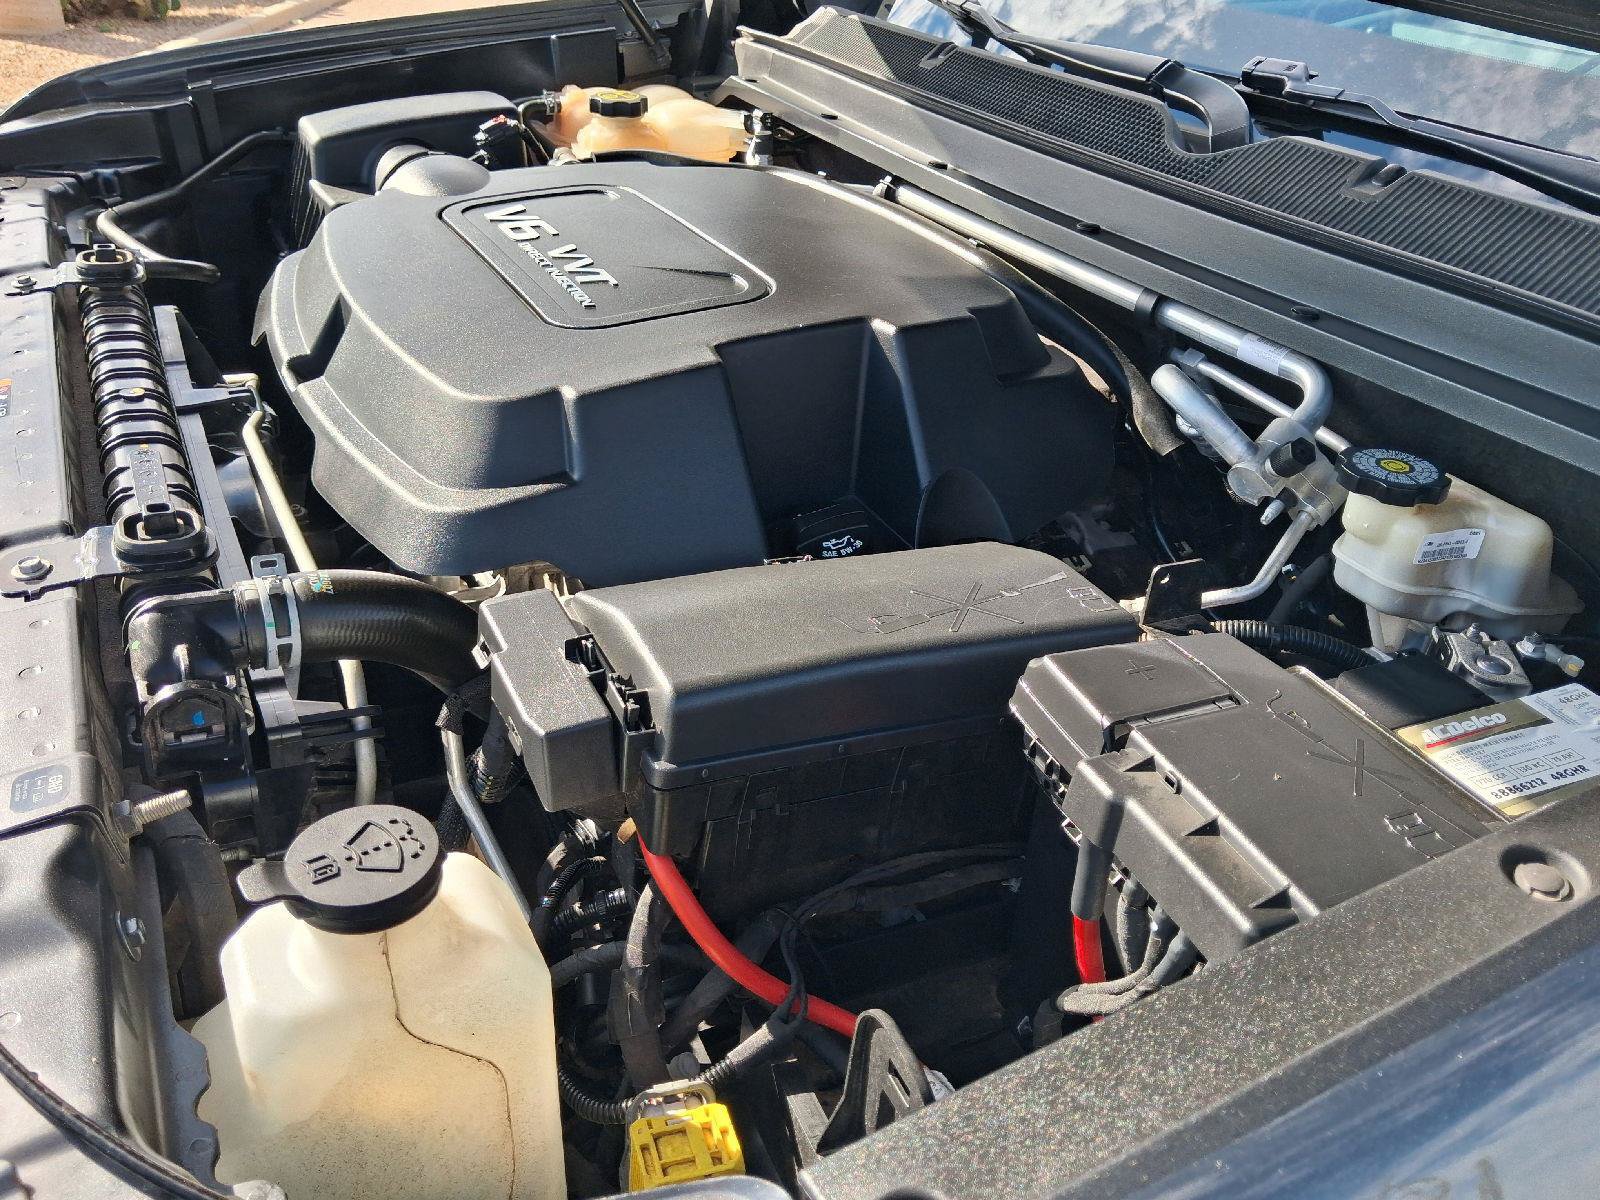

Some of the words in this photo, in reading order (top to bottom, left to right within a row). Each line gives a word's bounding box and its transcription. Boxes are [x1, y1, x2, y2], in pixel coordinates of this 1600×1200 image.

[484, 204, 560, 241] V6
[547, 243, 619, 286] VVT
[518, 241, 554, 268] DIRECT
[545, 267, 596, 308] INJECTION
[822, 550, 838, 558] SAE
[1422, 712, 1507, 743] ACDelco
[1550, 764, 1590, 781] 48GHR
